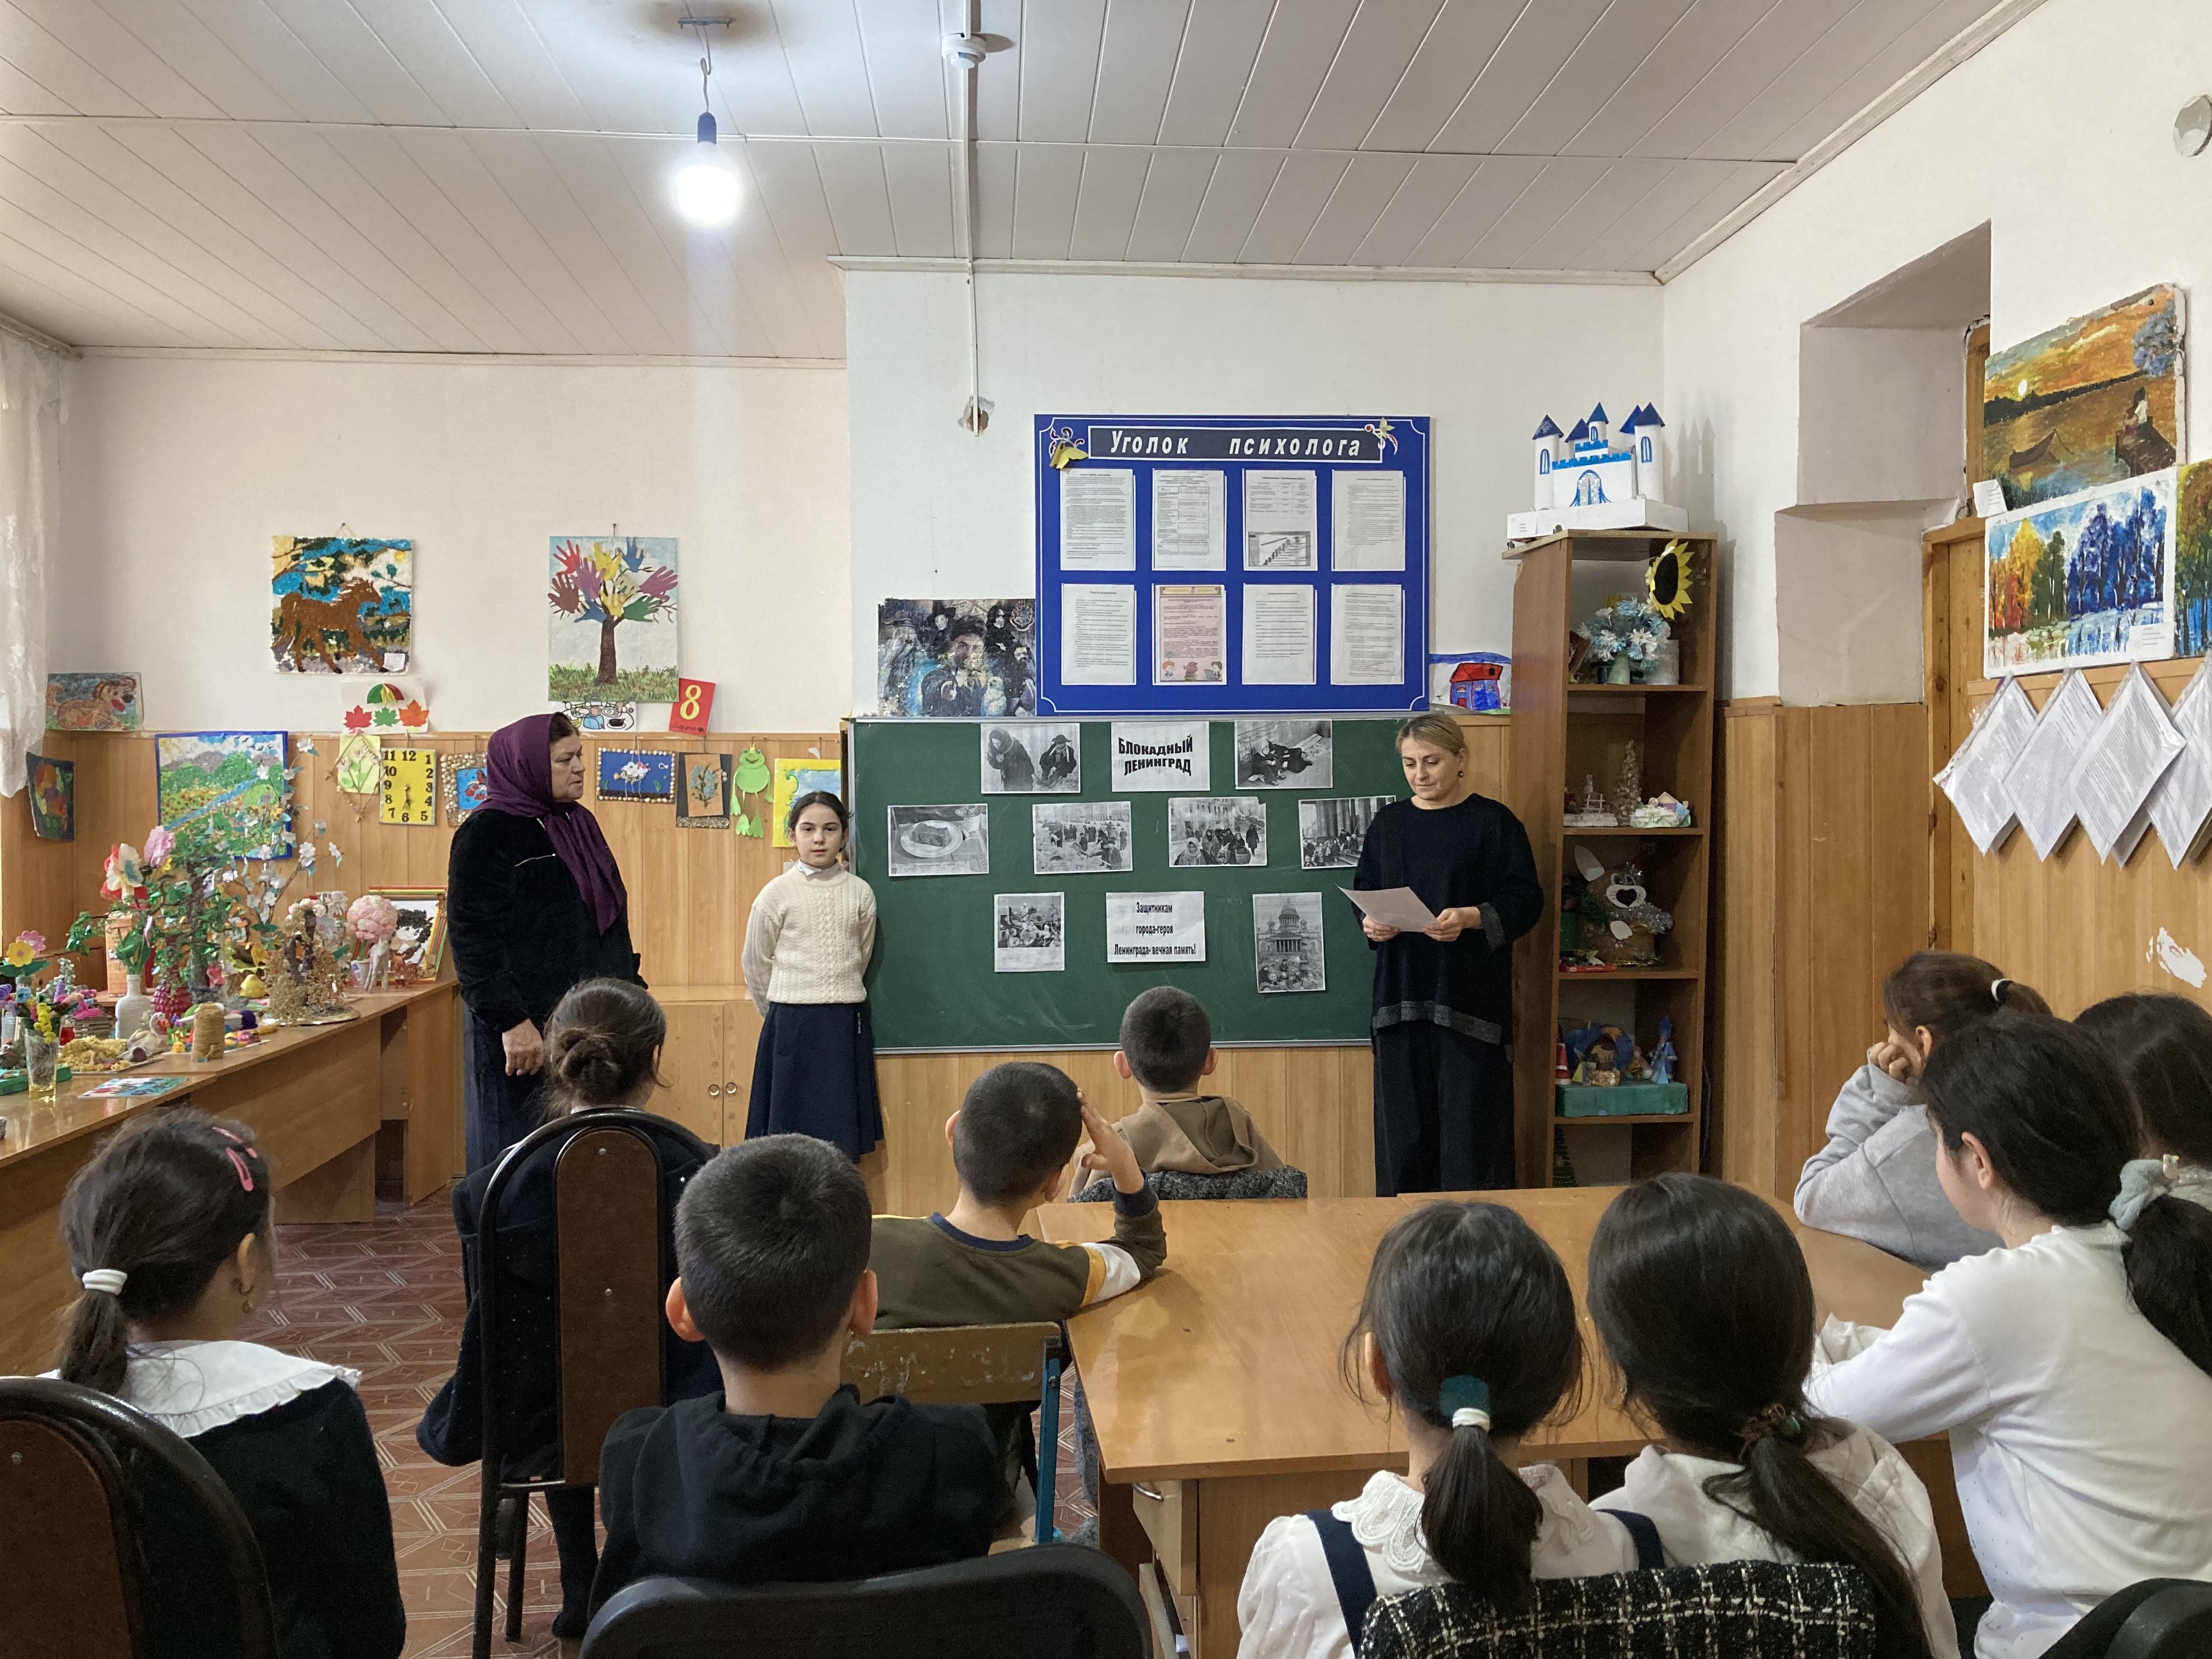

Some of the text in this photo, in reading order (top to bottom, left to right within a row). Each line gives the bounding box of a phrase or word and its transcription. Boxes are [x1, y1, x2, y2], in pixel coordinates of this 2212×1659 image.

[1110, 431, 1361, 456] Уголок психолога
[680, 684, 702, 720] 8
[1118, 733, 1193, 755] БЛОКАДНЫЙ
[384, 751, 416, 761] 11 12
[425, 754, 431, 765] 1
[384, 765, 397, 776] 10
[1124, 758, 1192, 776] ЛЕНИНГРАД
[426, 768, 433, 778] 2
[384, 780, 392, 790] 9
[426, 782, 432, 793] 3
[385, 794, 392, 804] 8
[425, 796, 432, 806] 4
[388, 808, 395, 819] 7
[402, 812, 409, 822] 6
[421, 811, 428, 821] 5
[1136, 902, 1172, 915] Защитникам
[1136, 925, 1173, 936] города-героя
[1152, 946, 1172, 955] вечная
[1174, 943, 1196, 955] память!
